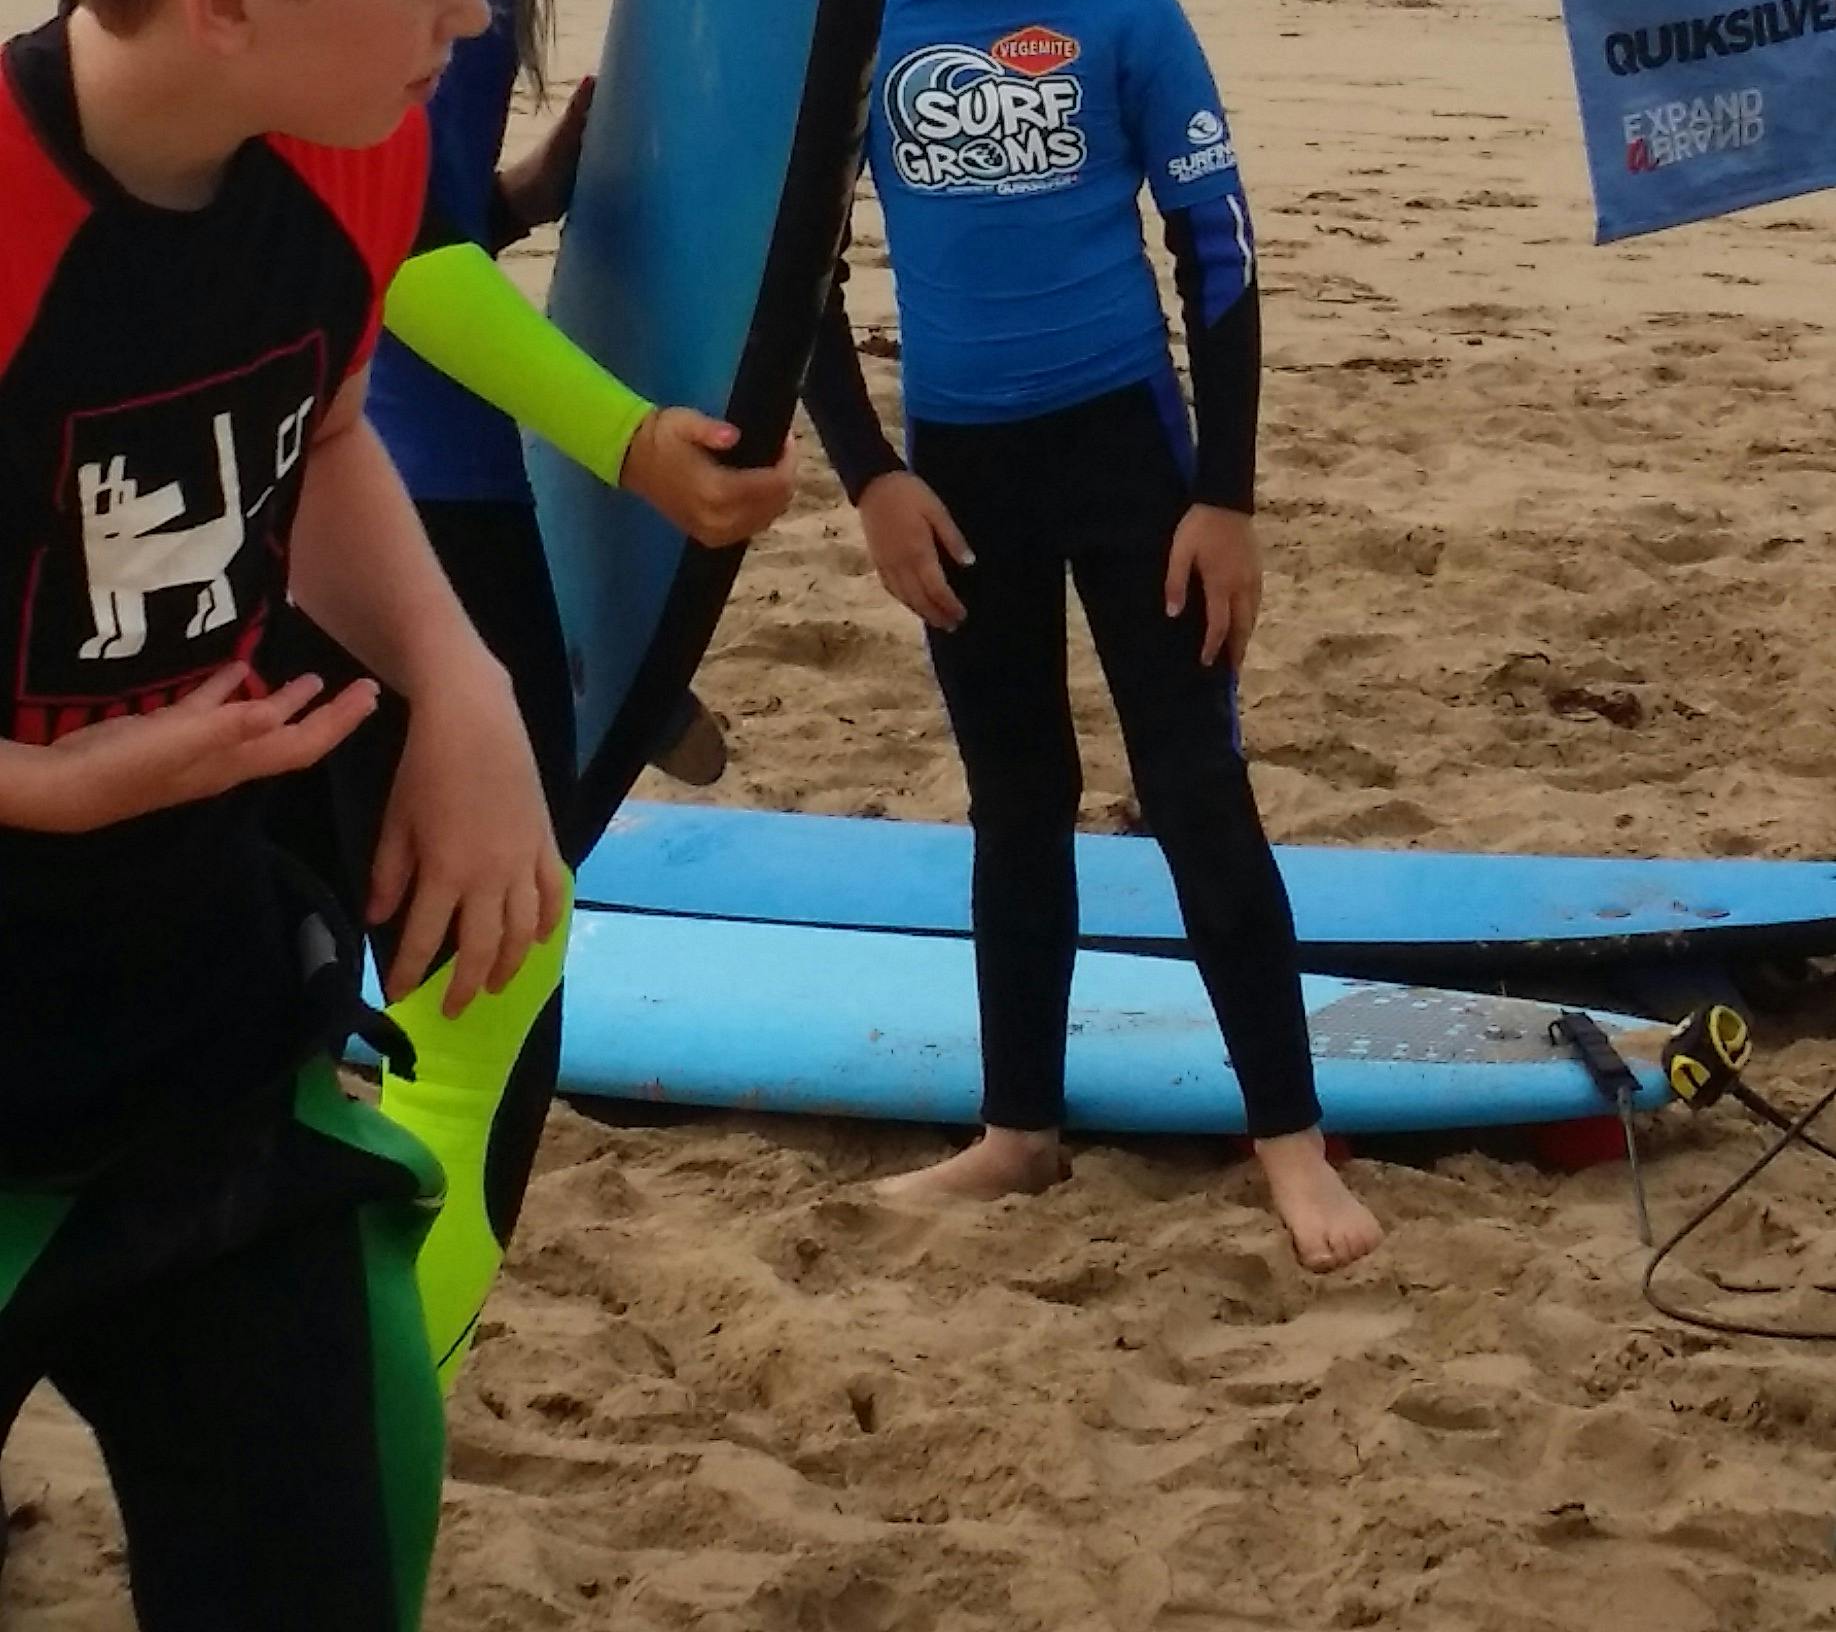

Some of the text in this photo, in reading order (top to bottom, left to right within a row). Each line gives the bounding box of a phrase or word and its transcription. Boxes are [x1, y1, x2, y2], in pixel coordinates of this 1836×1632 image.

[1000, 39, 1074, 58] VEGEMITE
[914, 79, 1077, 140] SURF
[1622, 87, 1763, 144] EXPAND
[898, 127, 1082, 183] GROMS
